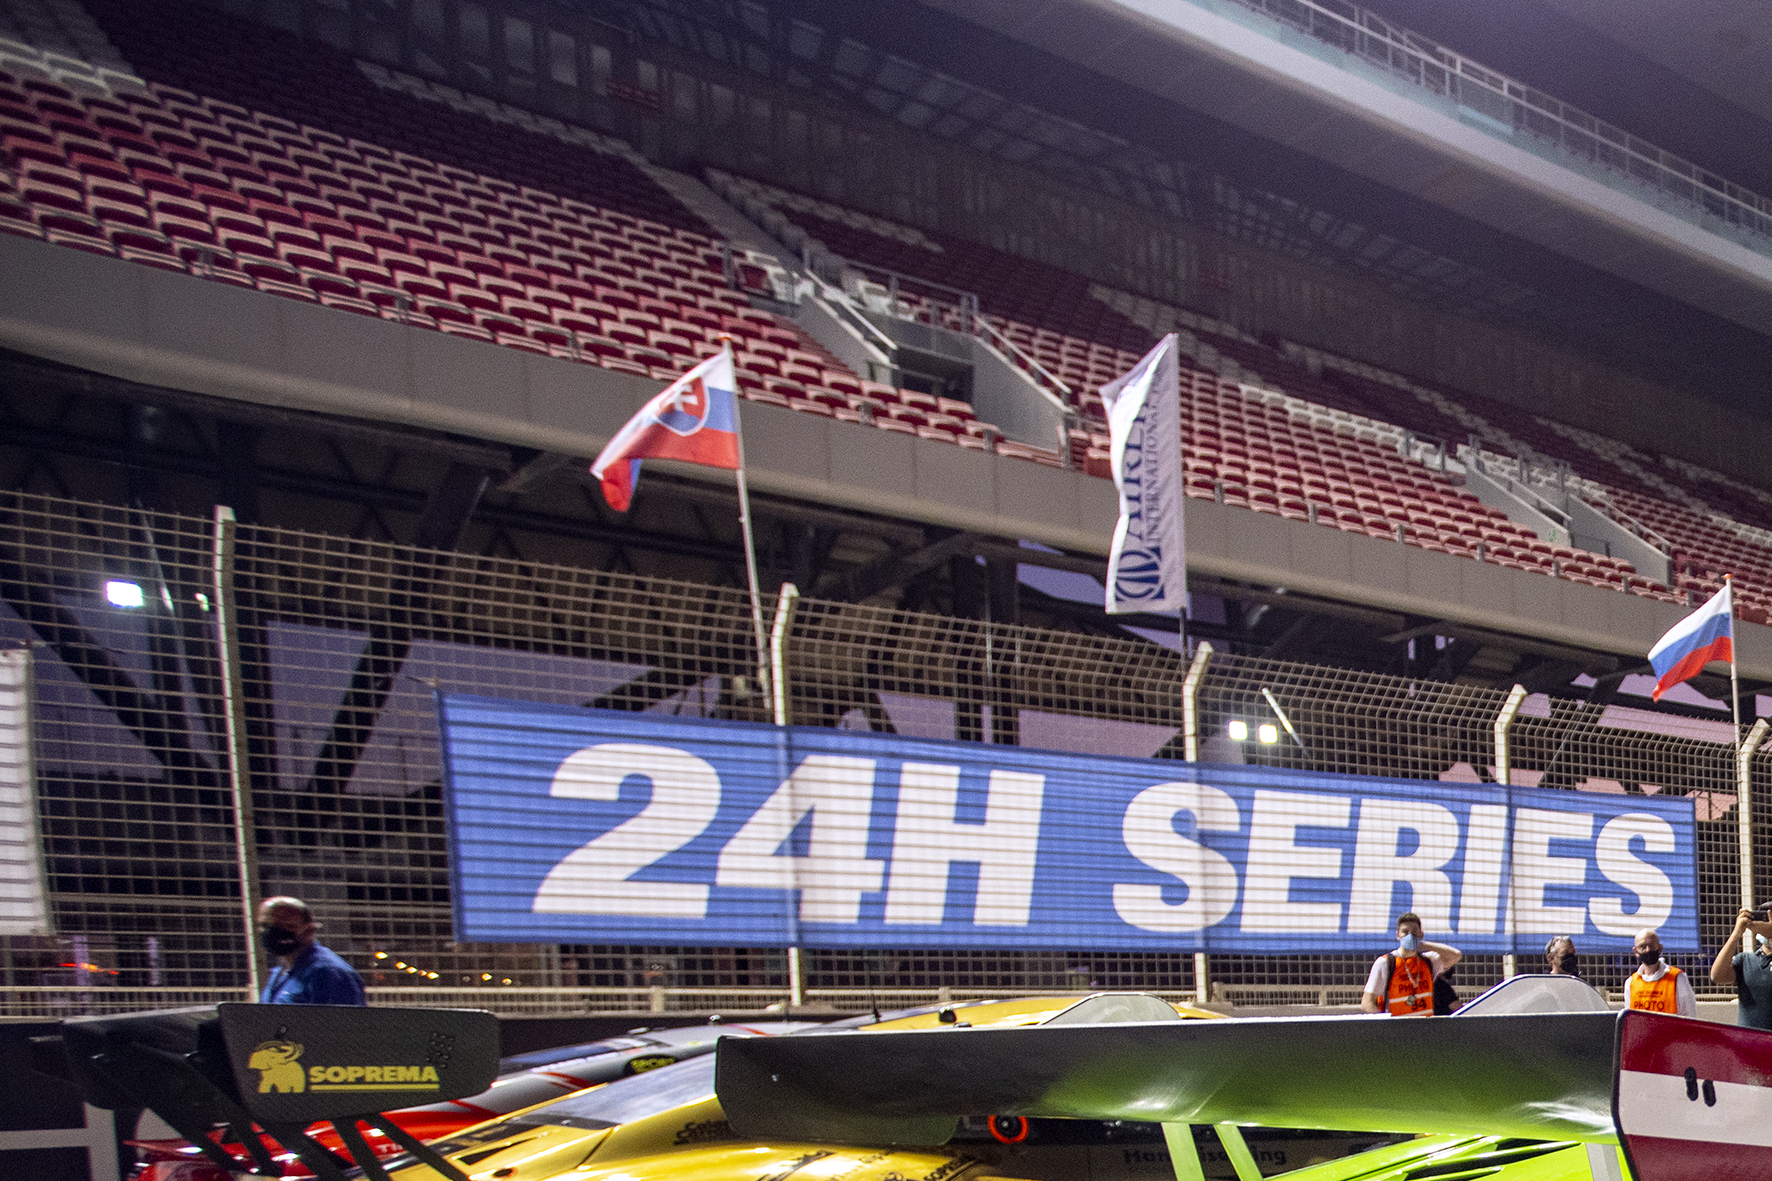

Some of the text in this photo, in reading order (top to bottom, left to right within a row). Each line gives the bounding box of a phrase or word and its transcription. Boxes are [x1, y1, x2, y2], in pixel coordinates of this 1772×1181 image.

[531, 743, 1677, 938] 24H SERIES
[309, 1065, 440, 1083] SOPREMA
